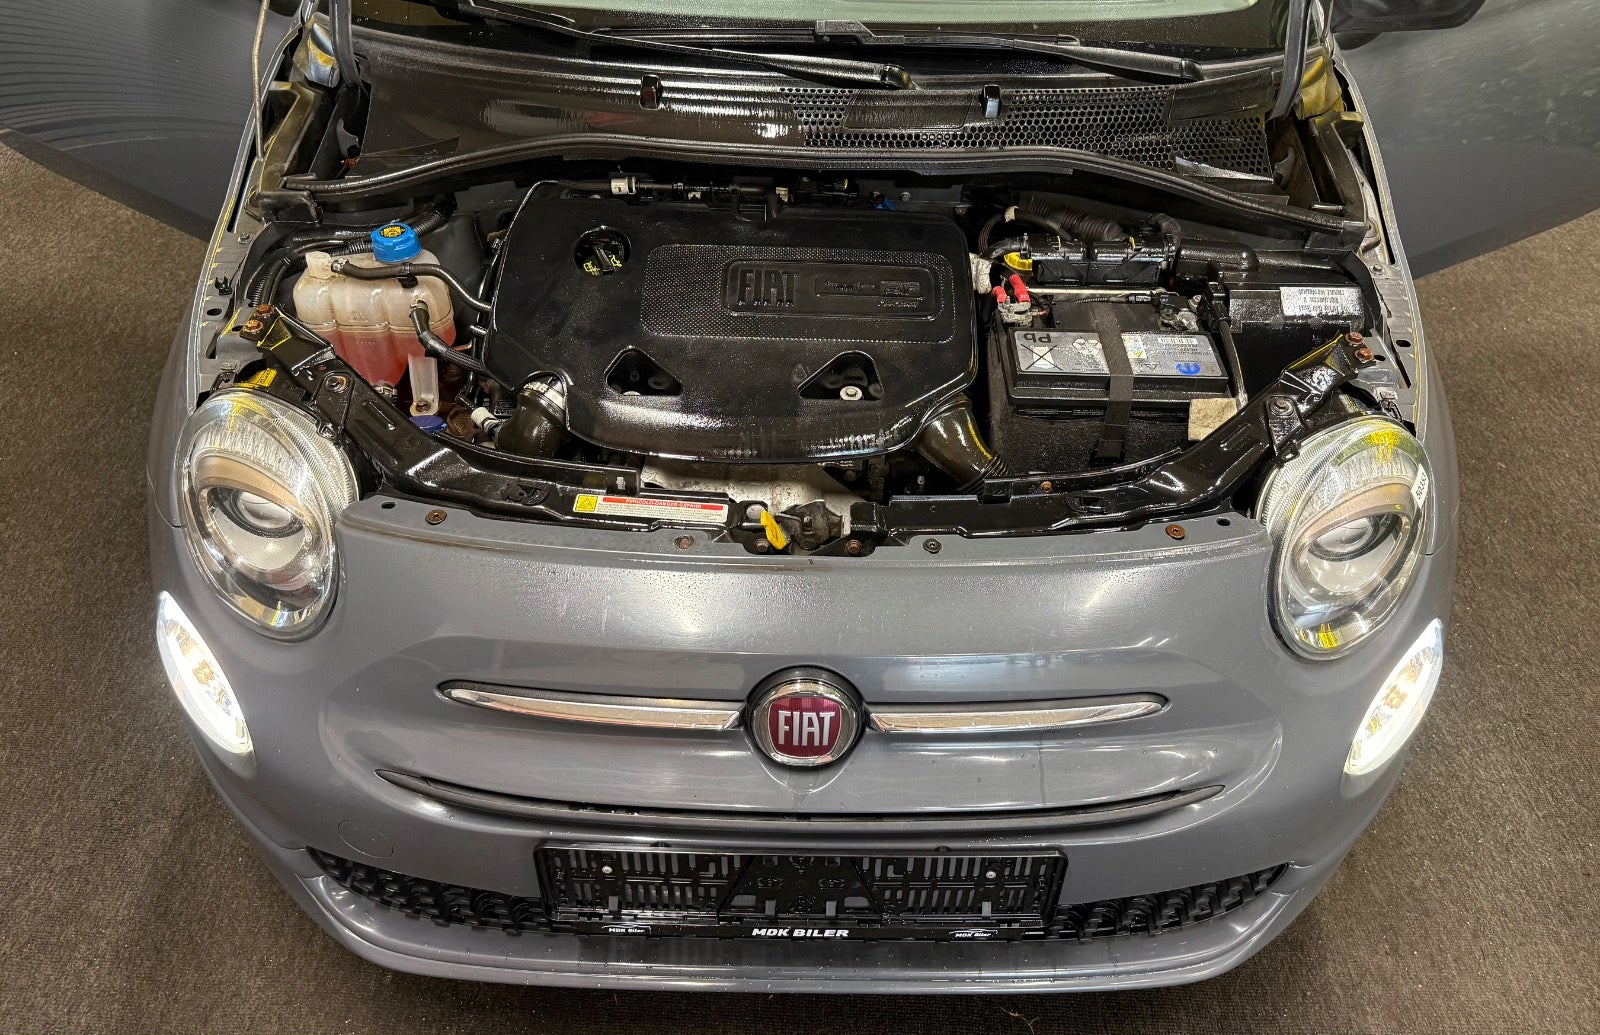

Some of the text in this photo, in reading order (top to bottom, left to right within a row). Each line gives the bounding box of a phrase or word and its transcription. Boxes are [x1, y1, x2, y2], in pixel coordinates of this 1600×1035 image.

[738, 268, 800, 305] FIAT
[1023, 332, 1051, 343] Pb
[778, 710, 836, 746] FIAT
[751, 923, 850, 938] MDK BILER
